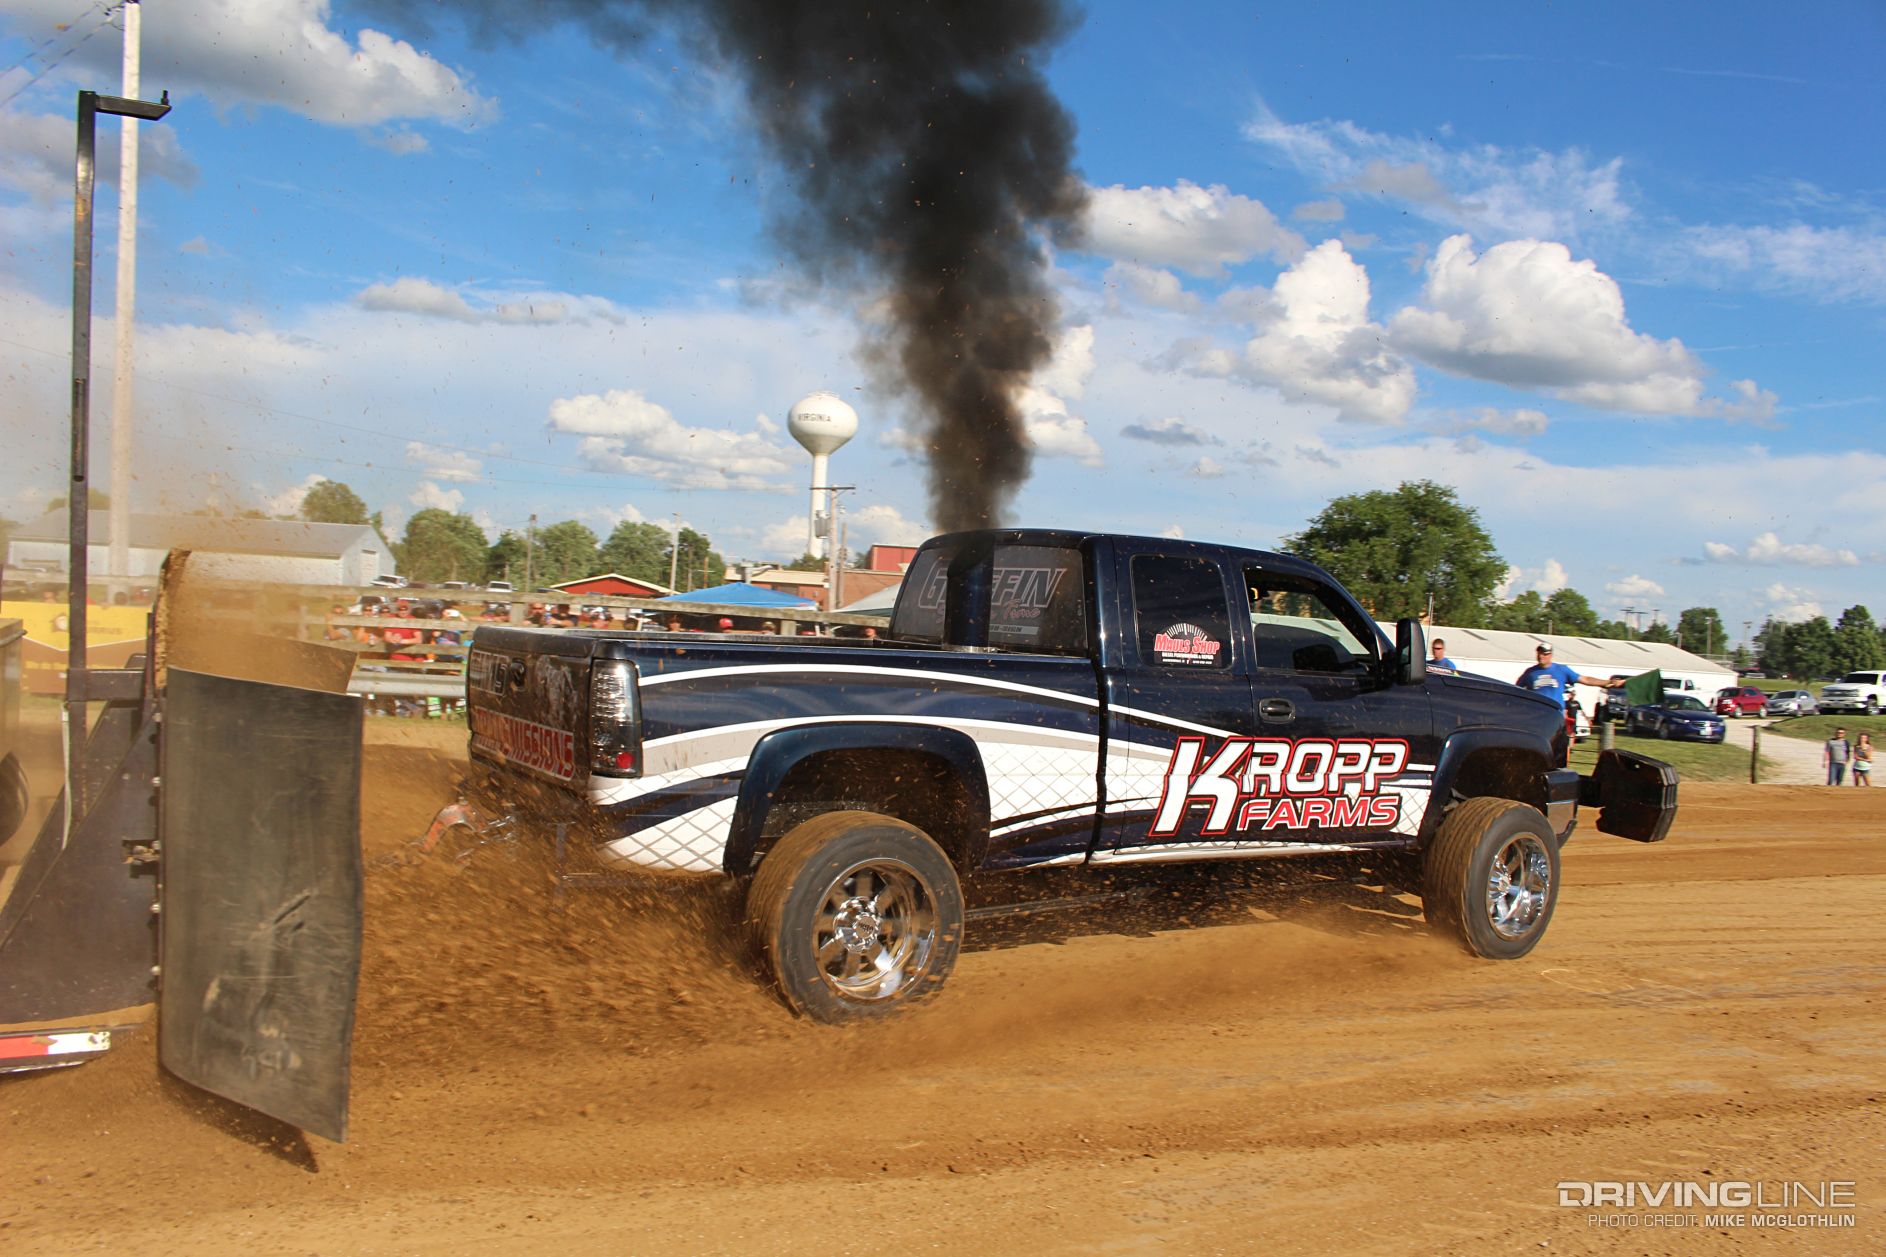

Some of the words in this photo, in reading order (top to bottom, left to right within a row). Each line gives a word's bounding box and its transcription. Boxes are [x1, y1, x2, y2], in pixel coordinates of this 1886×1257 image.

[1154, 633, 1191, 653] MAULS
[1192, 636, 1220, 654] SHOP
[1148, 736, 1409, 837] KROPP
[1236, 796, 1399, 831] FARMS
